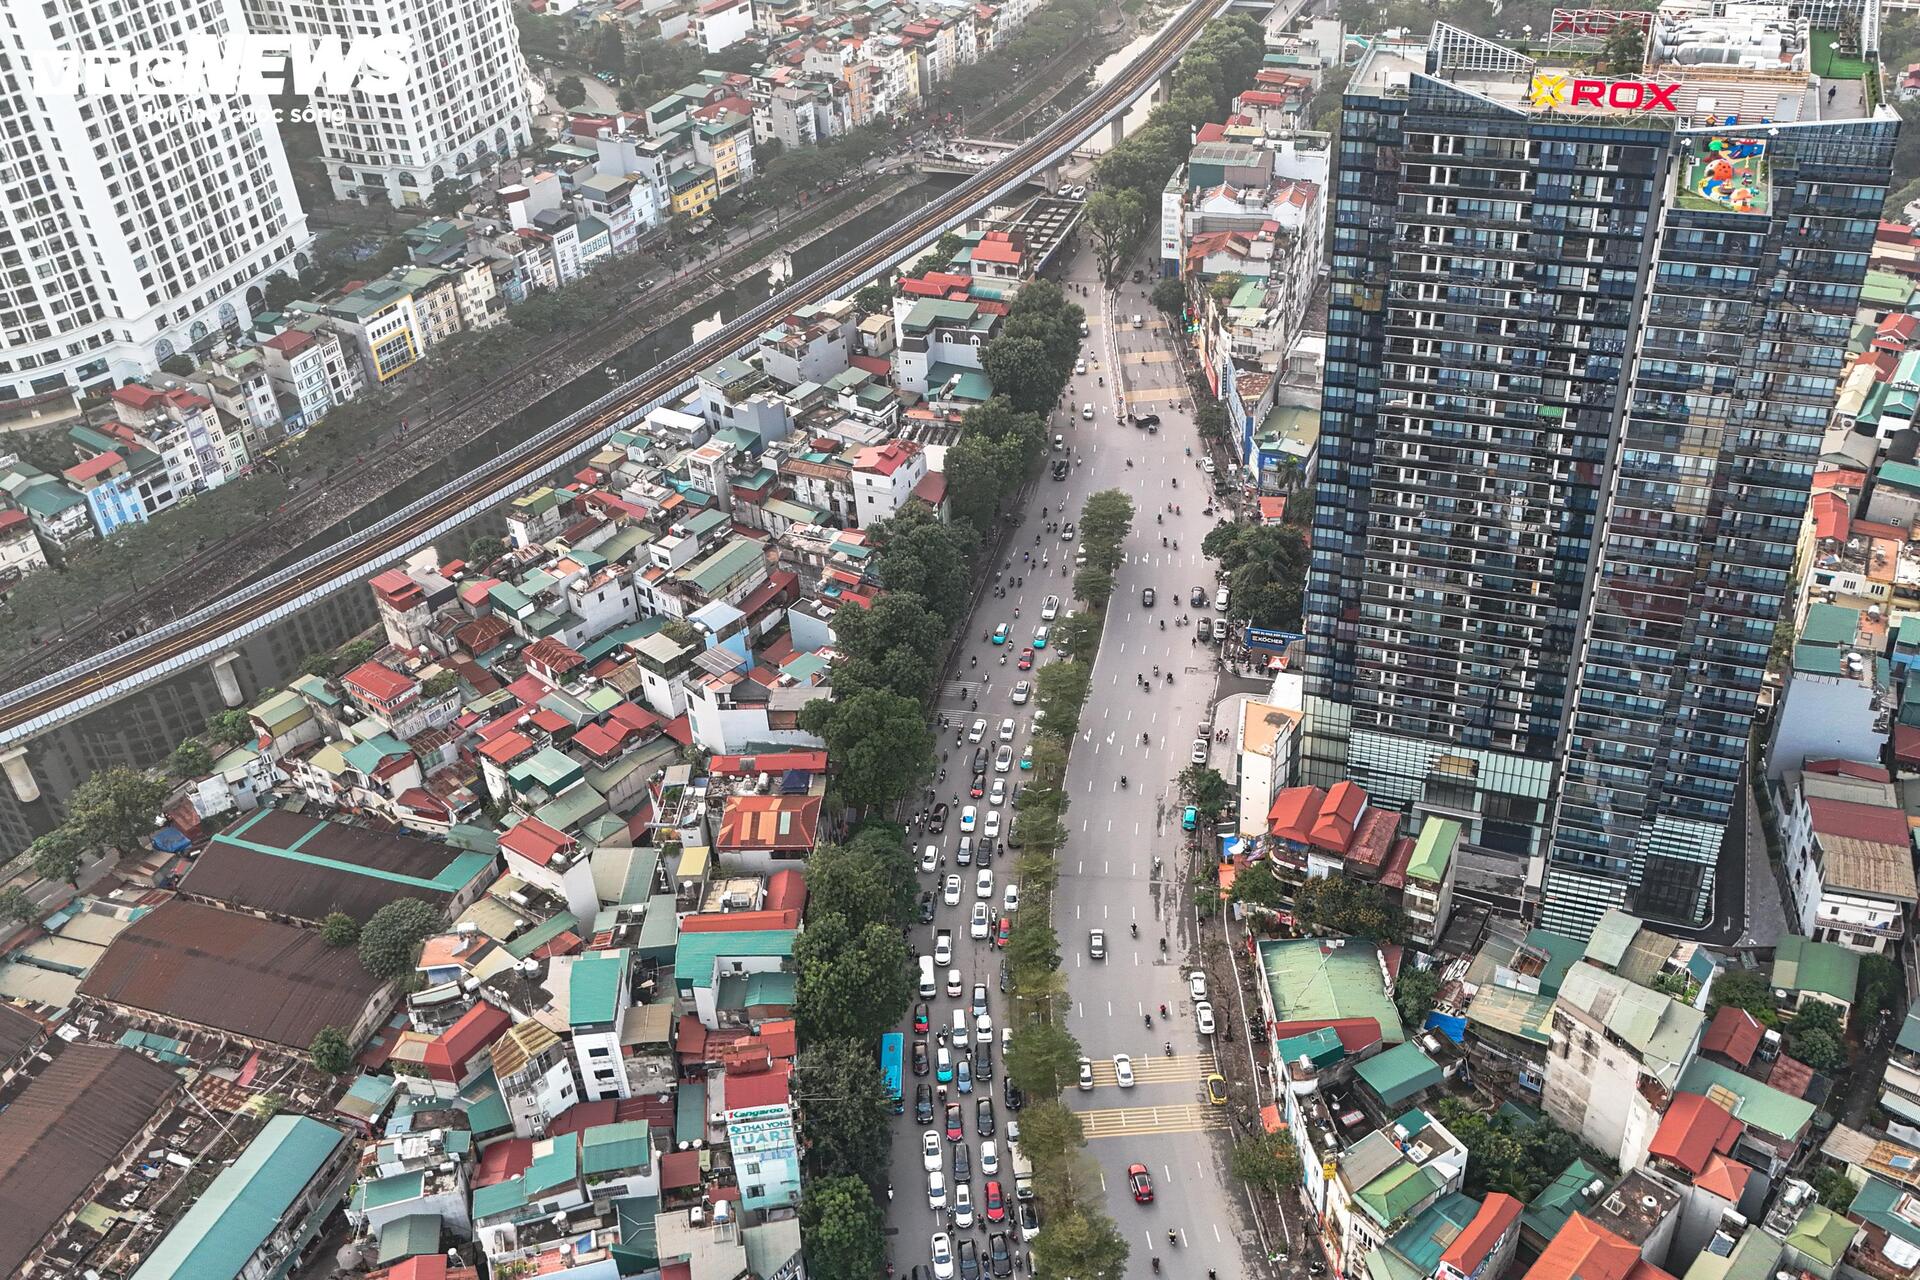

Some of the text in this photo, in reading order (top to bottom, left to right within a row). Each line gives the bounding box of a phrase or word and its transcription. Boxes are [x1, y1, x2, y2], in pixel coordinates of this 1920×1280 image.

[1571, 79, 1681, 112] ROX
[728, 1107, 784, 1119] Kangaroo
[731, 1129, 791, 1145] TUART
